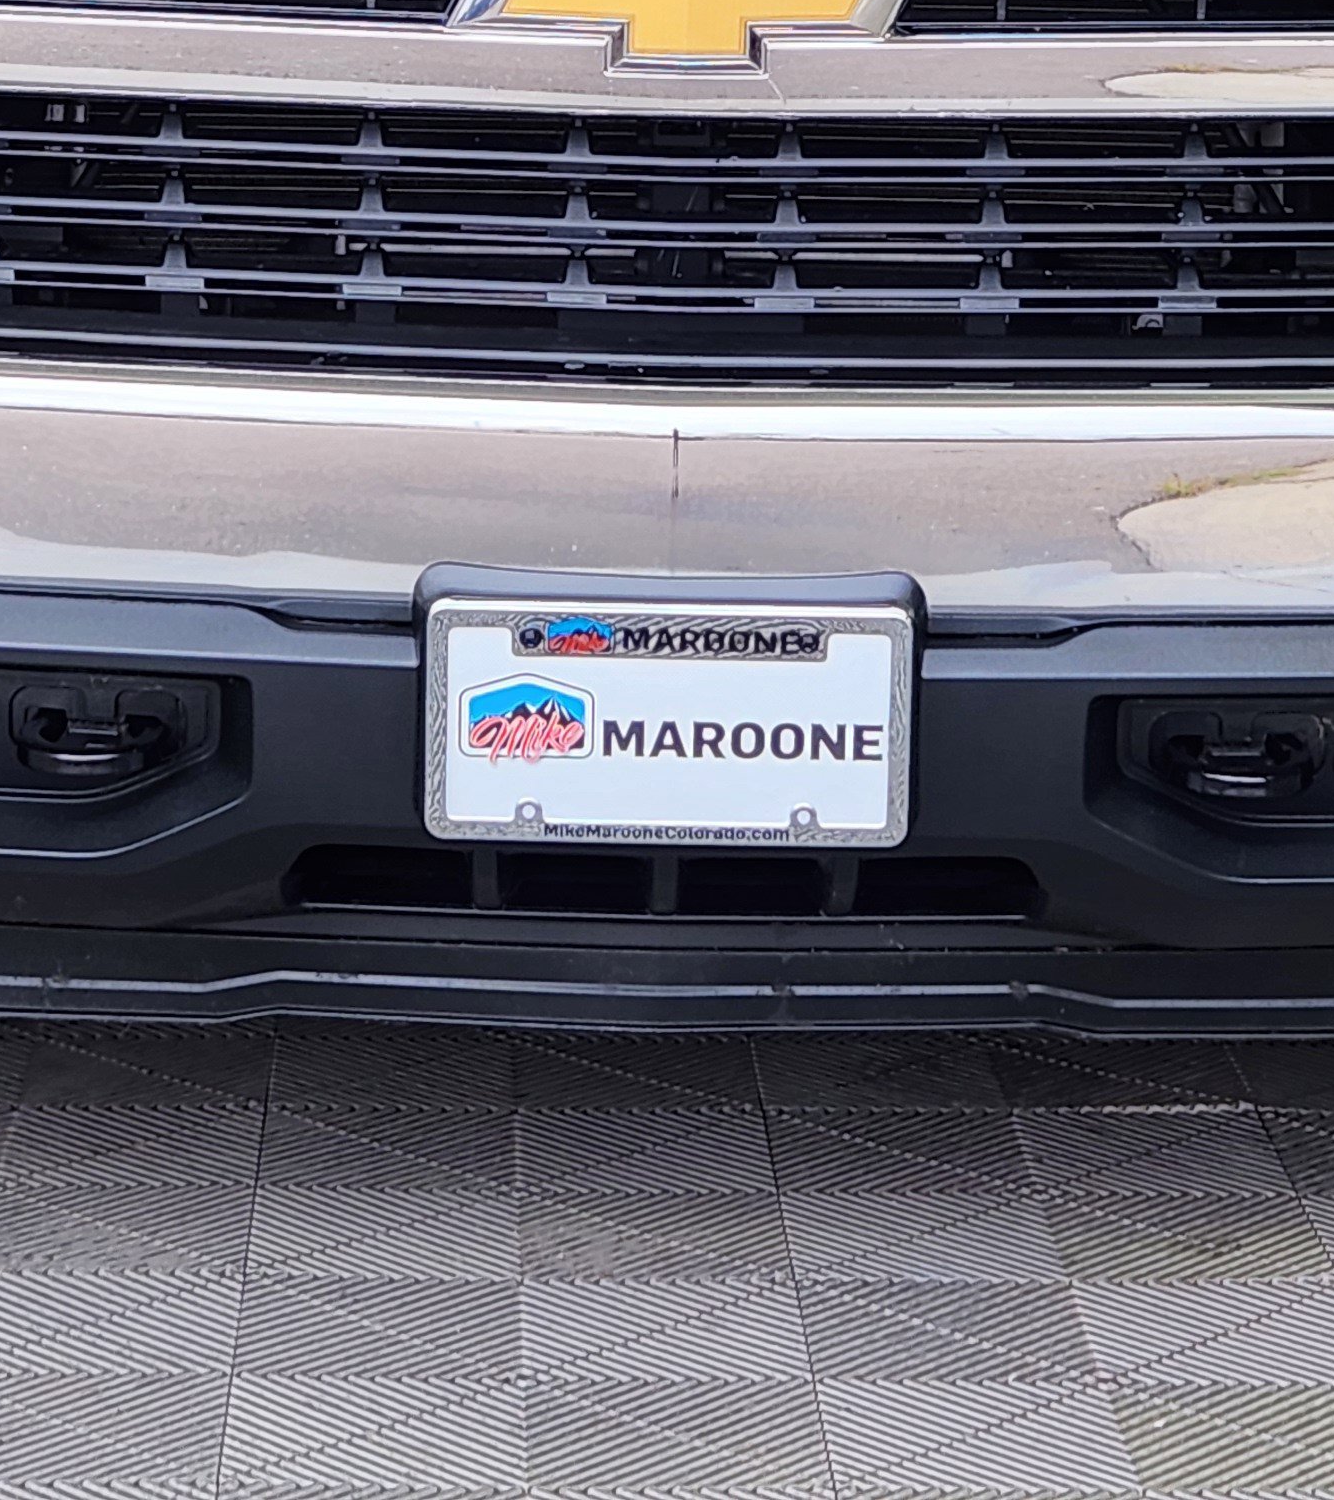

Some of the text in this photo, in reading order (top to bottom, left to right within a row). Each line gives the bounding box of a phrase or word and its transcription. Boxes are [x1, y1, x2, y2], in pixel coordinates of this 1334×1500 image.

[621, 626, 803, 654] MAROONE
[470, 712, 884, 765] Mike MAROONE
[544, 824, 790, 842] MikeMarooneColorado.com
